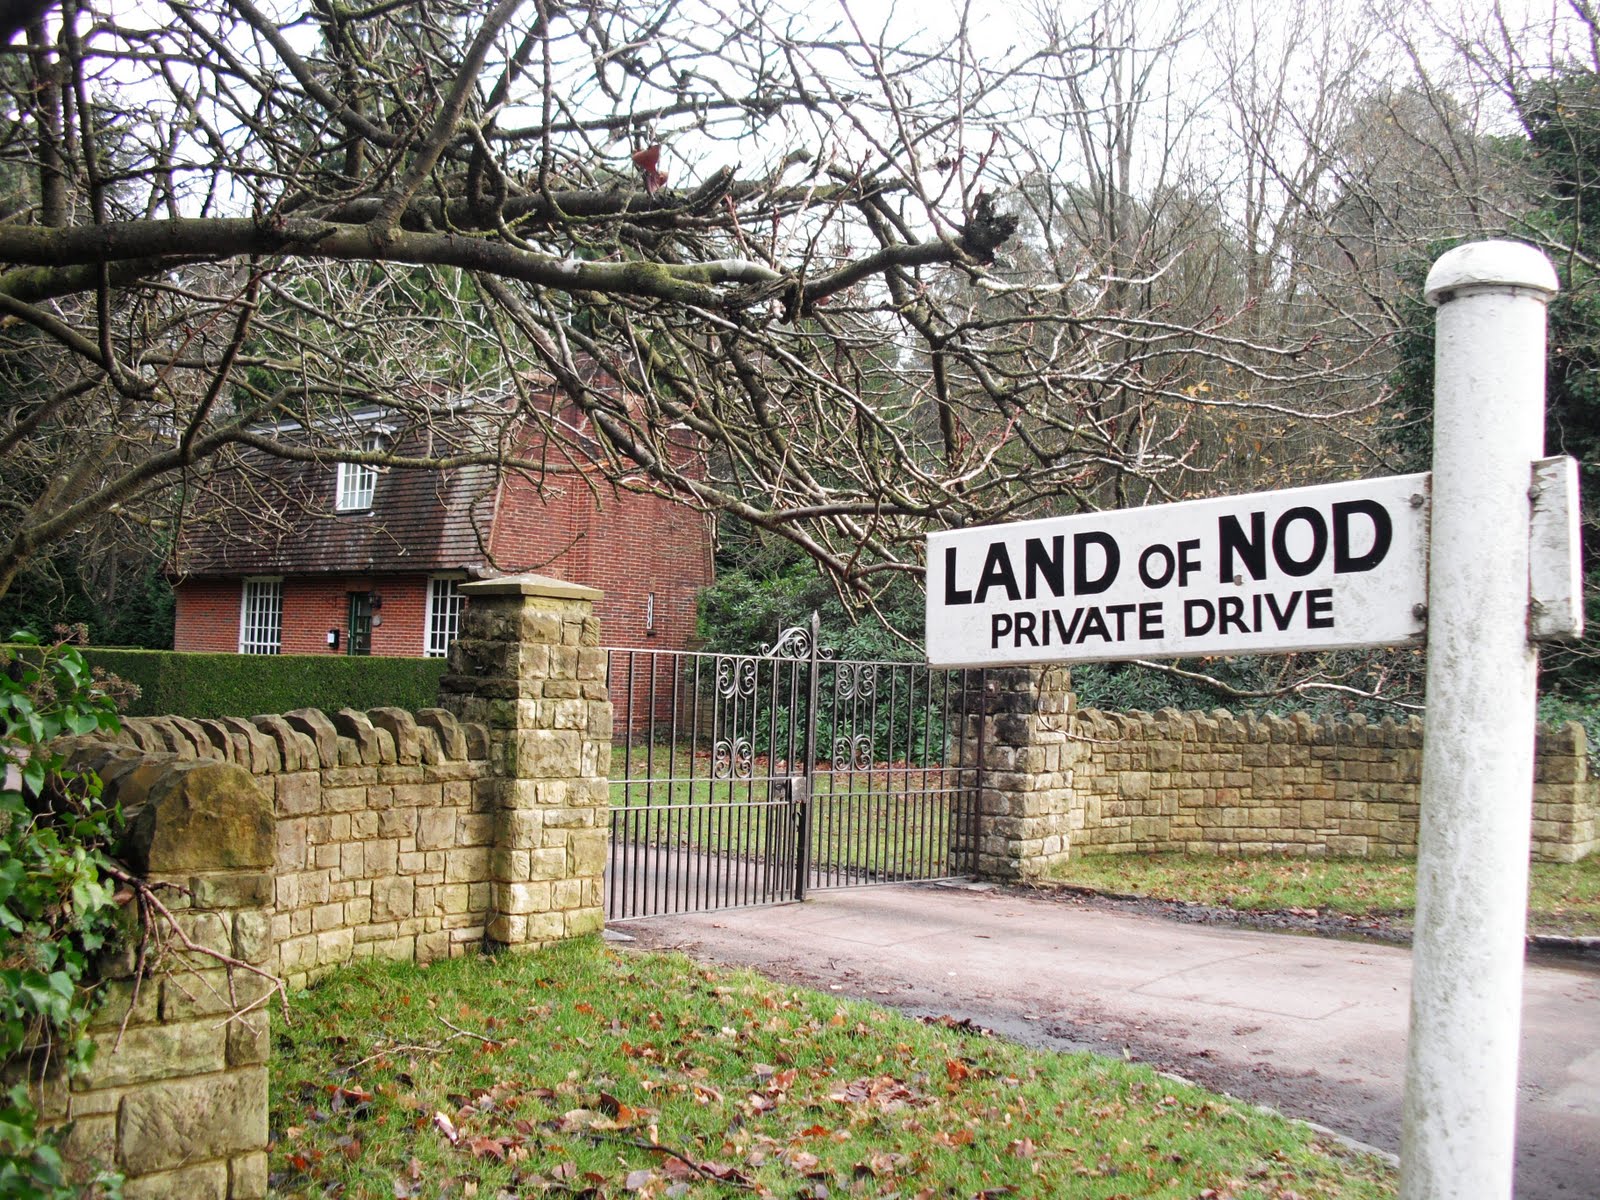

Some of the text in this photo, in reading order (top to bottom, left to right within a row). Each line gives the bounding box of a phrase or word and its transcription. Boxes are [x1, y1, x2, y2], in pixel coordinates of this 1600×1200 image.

[944, 499, 1393, 606] LAND OF NOD
[991, 588, 1335, 649] PRIVATE DRIVE
